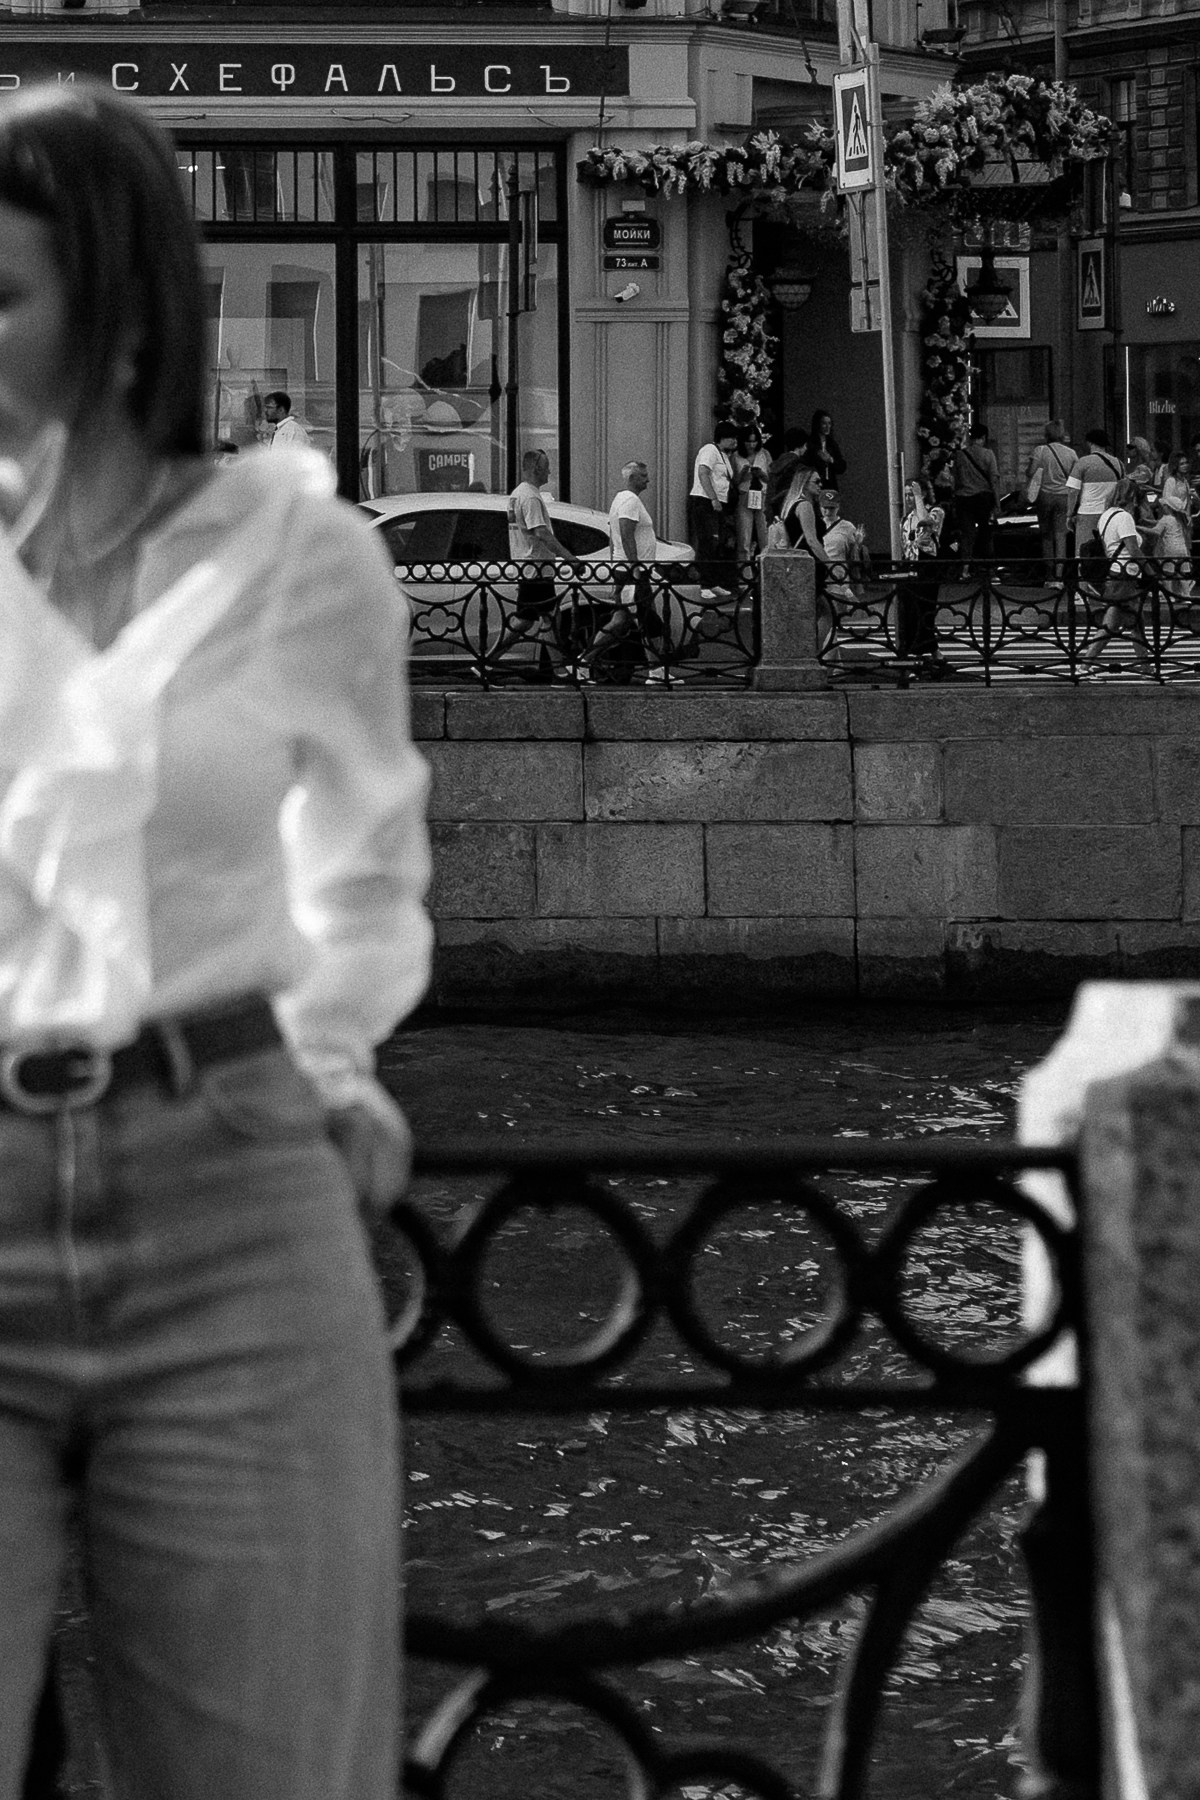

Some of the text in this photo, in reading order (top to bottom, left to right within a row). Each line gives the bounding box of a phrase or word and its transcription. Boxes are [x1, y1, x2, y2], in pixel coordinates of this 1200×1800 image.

[111, 63, 570, 93] СХЕФАЛЬСЪ
[613, 228, 651, 239] МОЙКИ
[615, 257, 627, 268] 73
[428, 453, 471, 471] CAMPE
